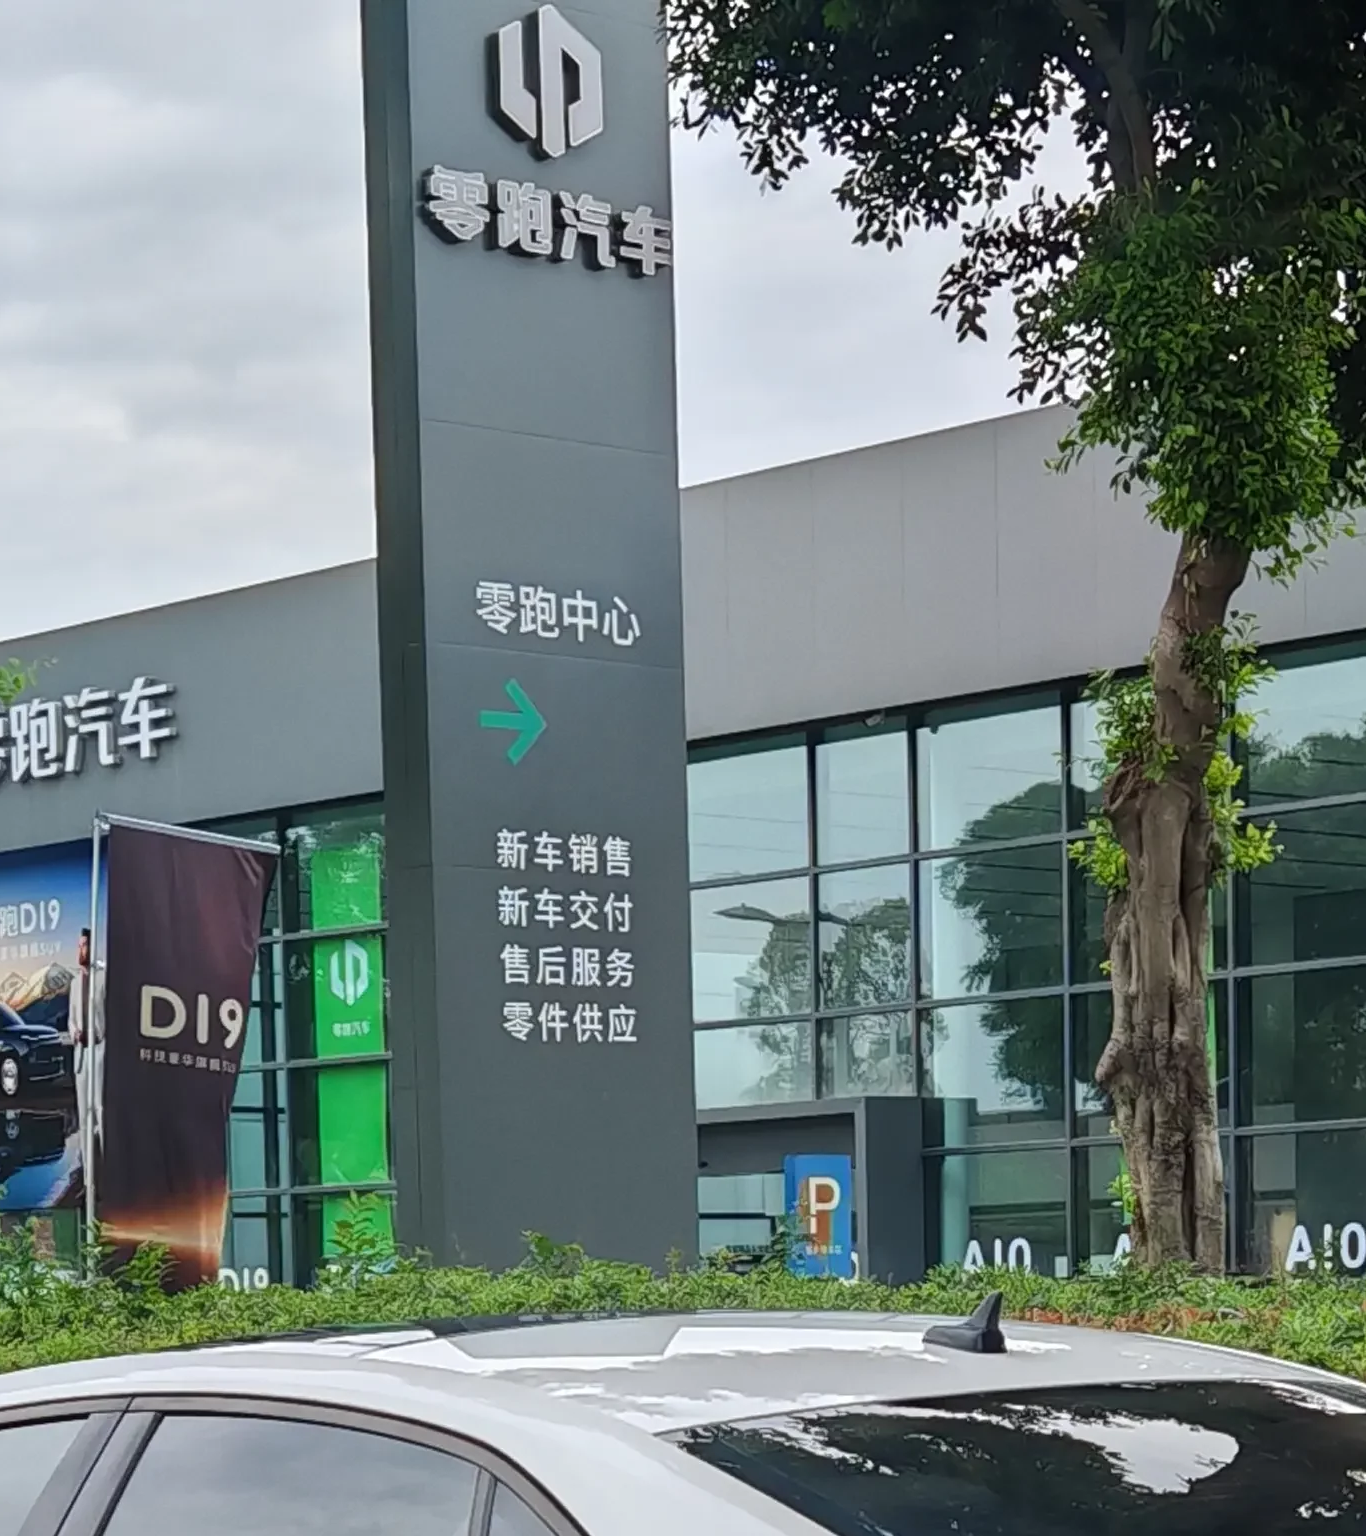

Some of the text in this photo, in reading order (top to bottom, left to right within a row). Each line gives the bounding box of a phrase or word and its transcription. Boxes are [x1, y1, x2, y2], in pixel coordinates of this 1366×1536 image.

[428, 164, 672, 277] 零跑汽车
[474, 580, 642, 647] 零跑中心
[496, 829, 632, 877] 新车销售
[497, 886, 634, 933] 新车交付
[500, 944, 635, 988] 售后服务
[140, 984, 244, 1049] D19
[502, 1002, 638, 1043] 零件供应
[808, 1176, 841, 1235] P
